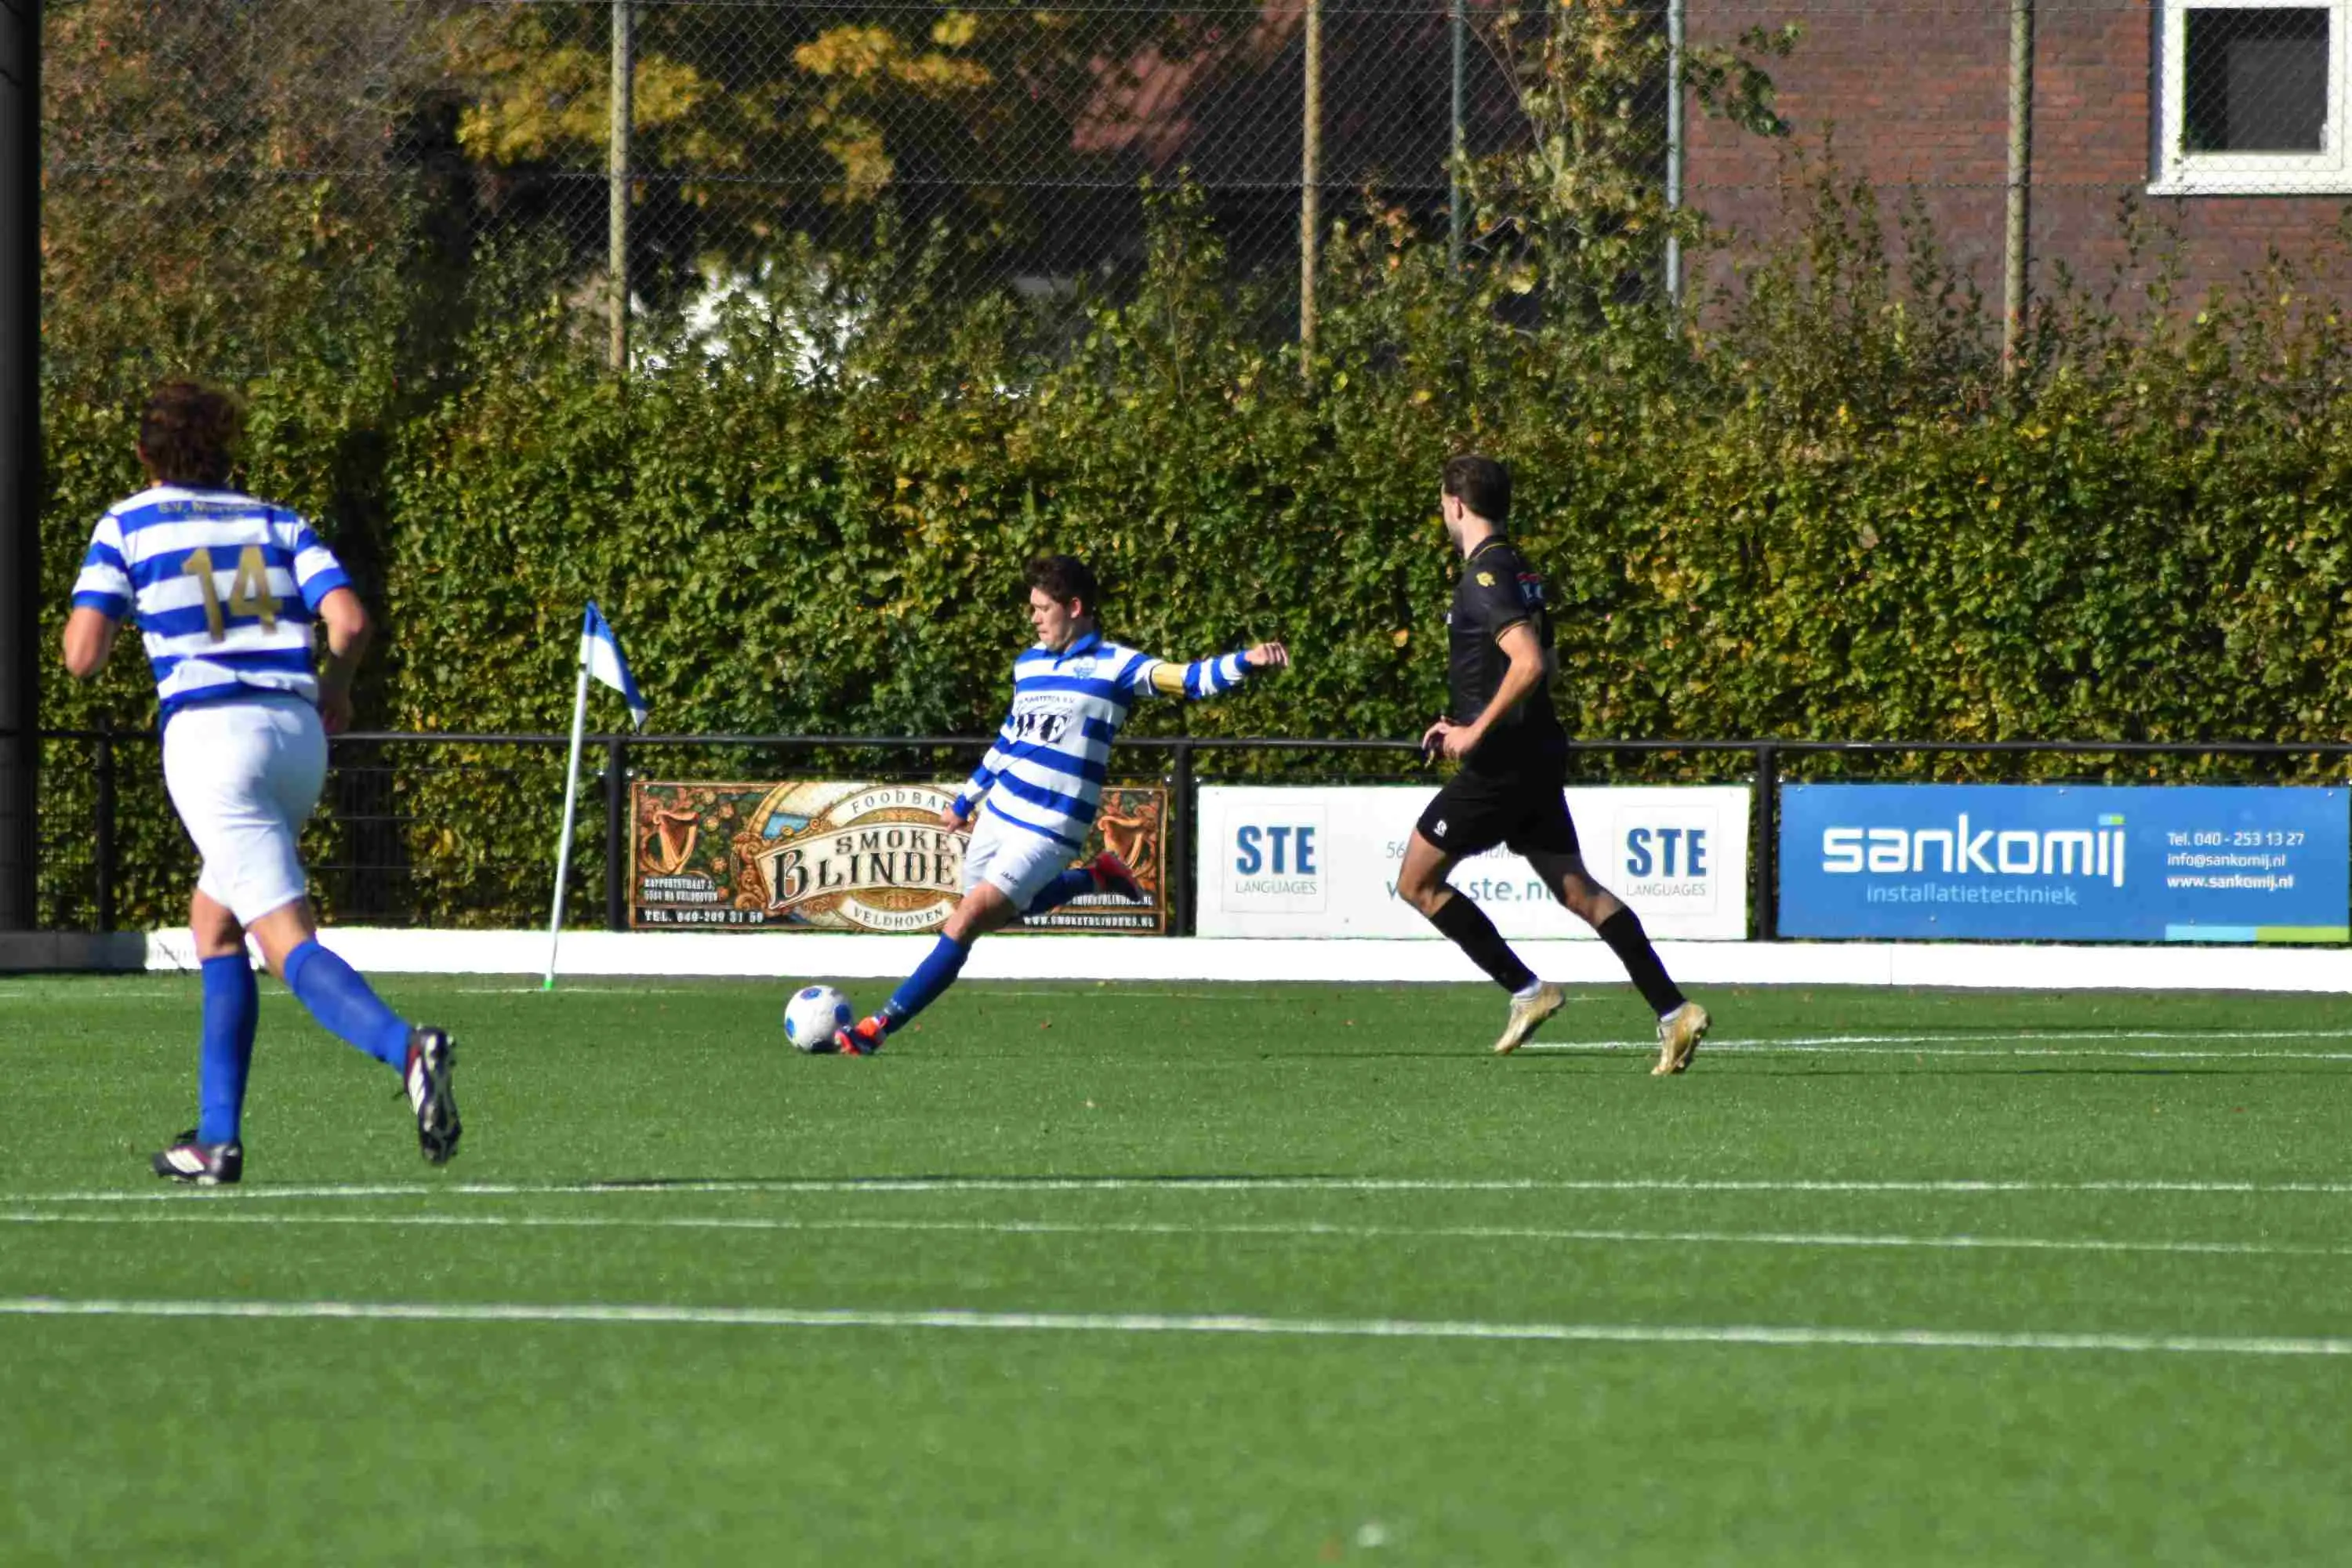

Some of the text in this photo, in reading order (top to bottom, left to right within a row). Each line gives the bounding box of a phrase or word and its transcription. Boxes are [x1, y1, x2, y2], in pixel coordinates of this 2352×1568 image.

[182, 544, 283, 644] 14
[836, 829, 970, 855] SMOKEY
[1823, 812, 2125, 887] sankomij
[2166, 832, 2190, 846] Tel.
[2194, 833, 2222, 846] 040
[2233, 833, 2261, 846] 253
[2266, 833, 2283, 846] 13
[2285, 833, 2305, 846] 27
[1236, 826, 1316, 876] STE
[1627, 827, 1707, 877] STE
[2167, 853, 2286, 870] info@sankomij.nl
[769, 848, 956, 908] BLINDE
[1235, 880, 1317, 895] LANGUAGES
[2166, 874, 2294, 891] www.sankomij.nl
[1626, 883, 1707, 897] LANGUAGES
[1866, 882, 2078, 906] installatietechniek
[644, 909, 673, 922] TEL.
[854, 906, 943, 926] VELDHOVEN
